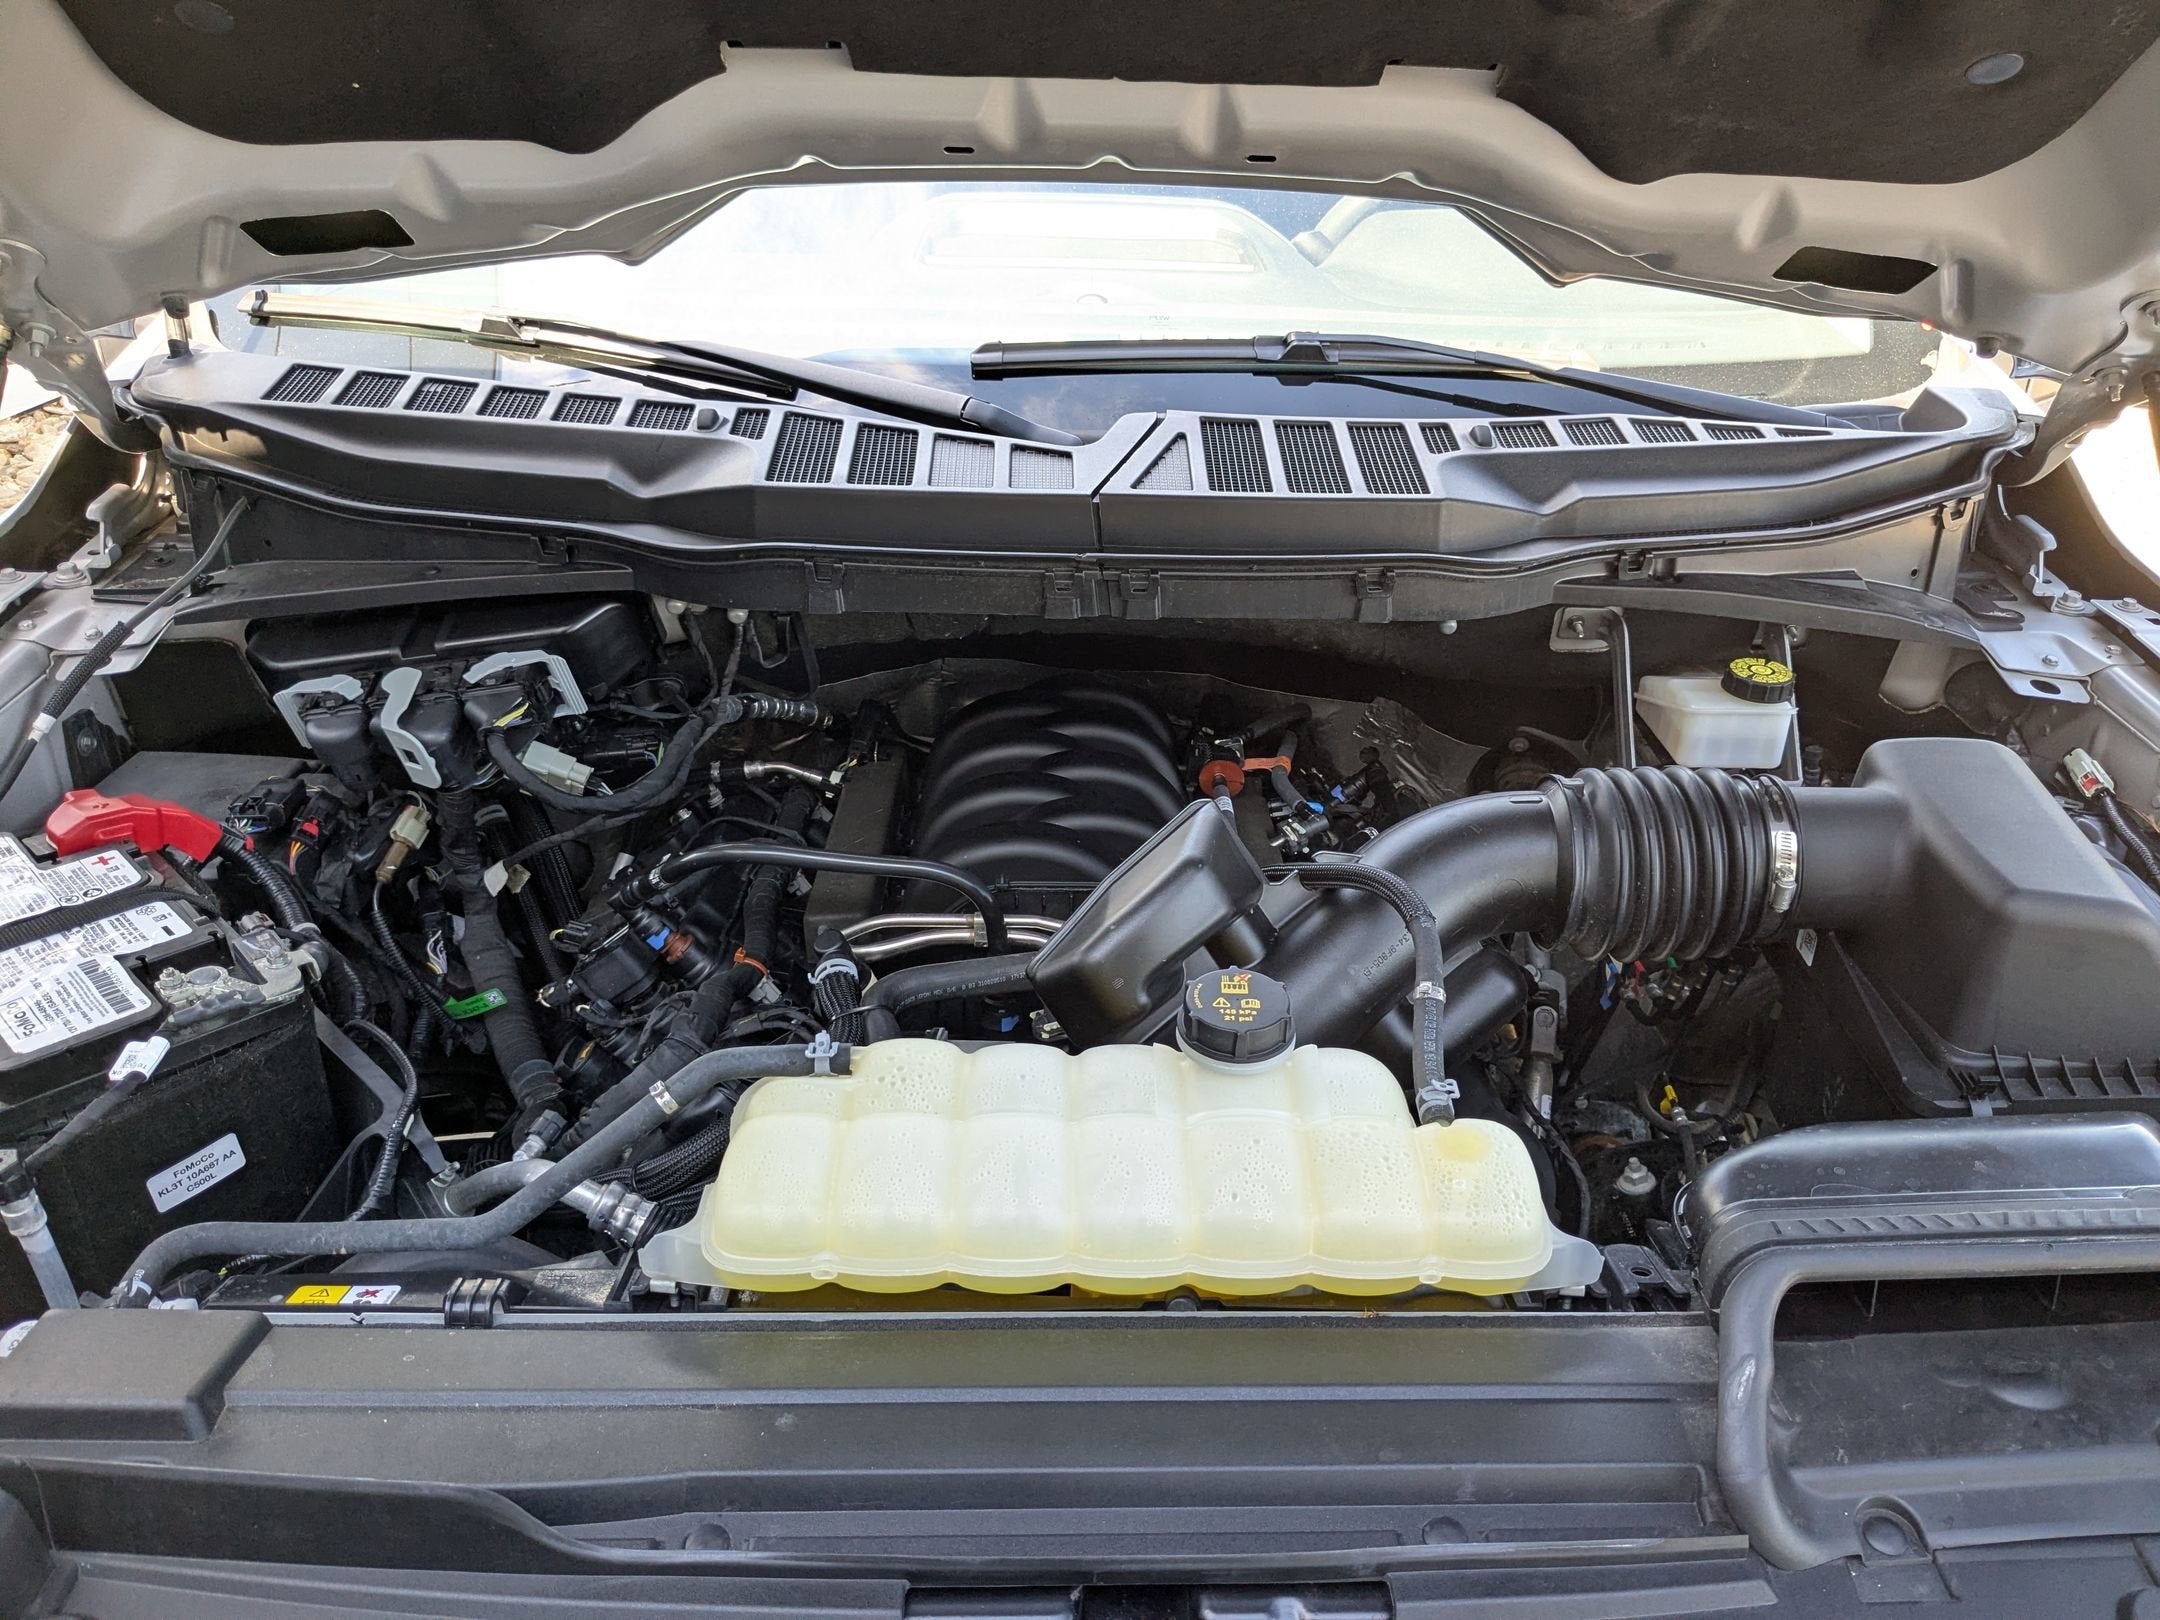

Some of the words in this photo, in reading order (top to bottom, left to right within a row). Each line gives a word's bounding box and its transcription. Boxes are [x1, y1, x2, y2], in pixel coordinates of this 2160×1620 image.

[158, 1180, 183, 1198] KL3T
[187, 1158, 220, 1182] 10A687
[223, 1149, 237, 1161] AA
[173, 1152, 215, 1178] FoMoCo
[186, 1172, 218, 1192] C500L
